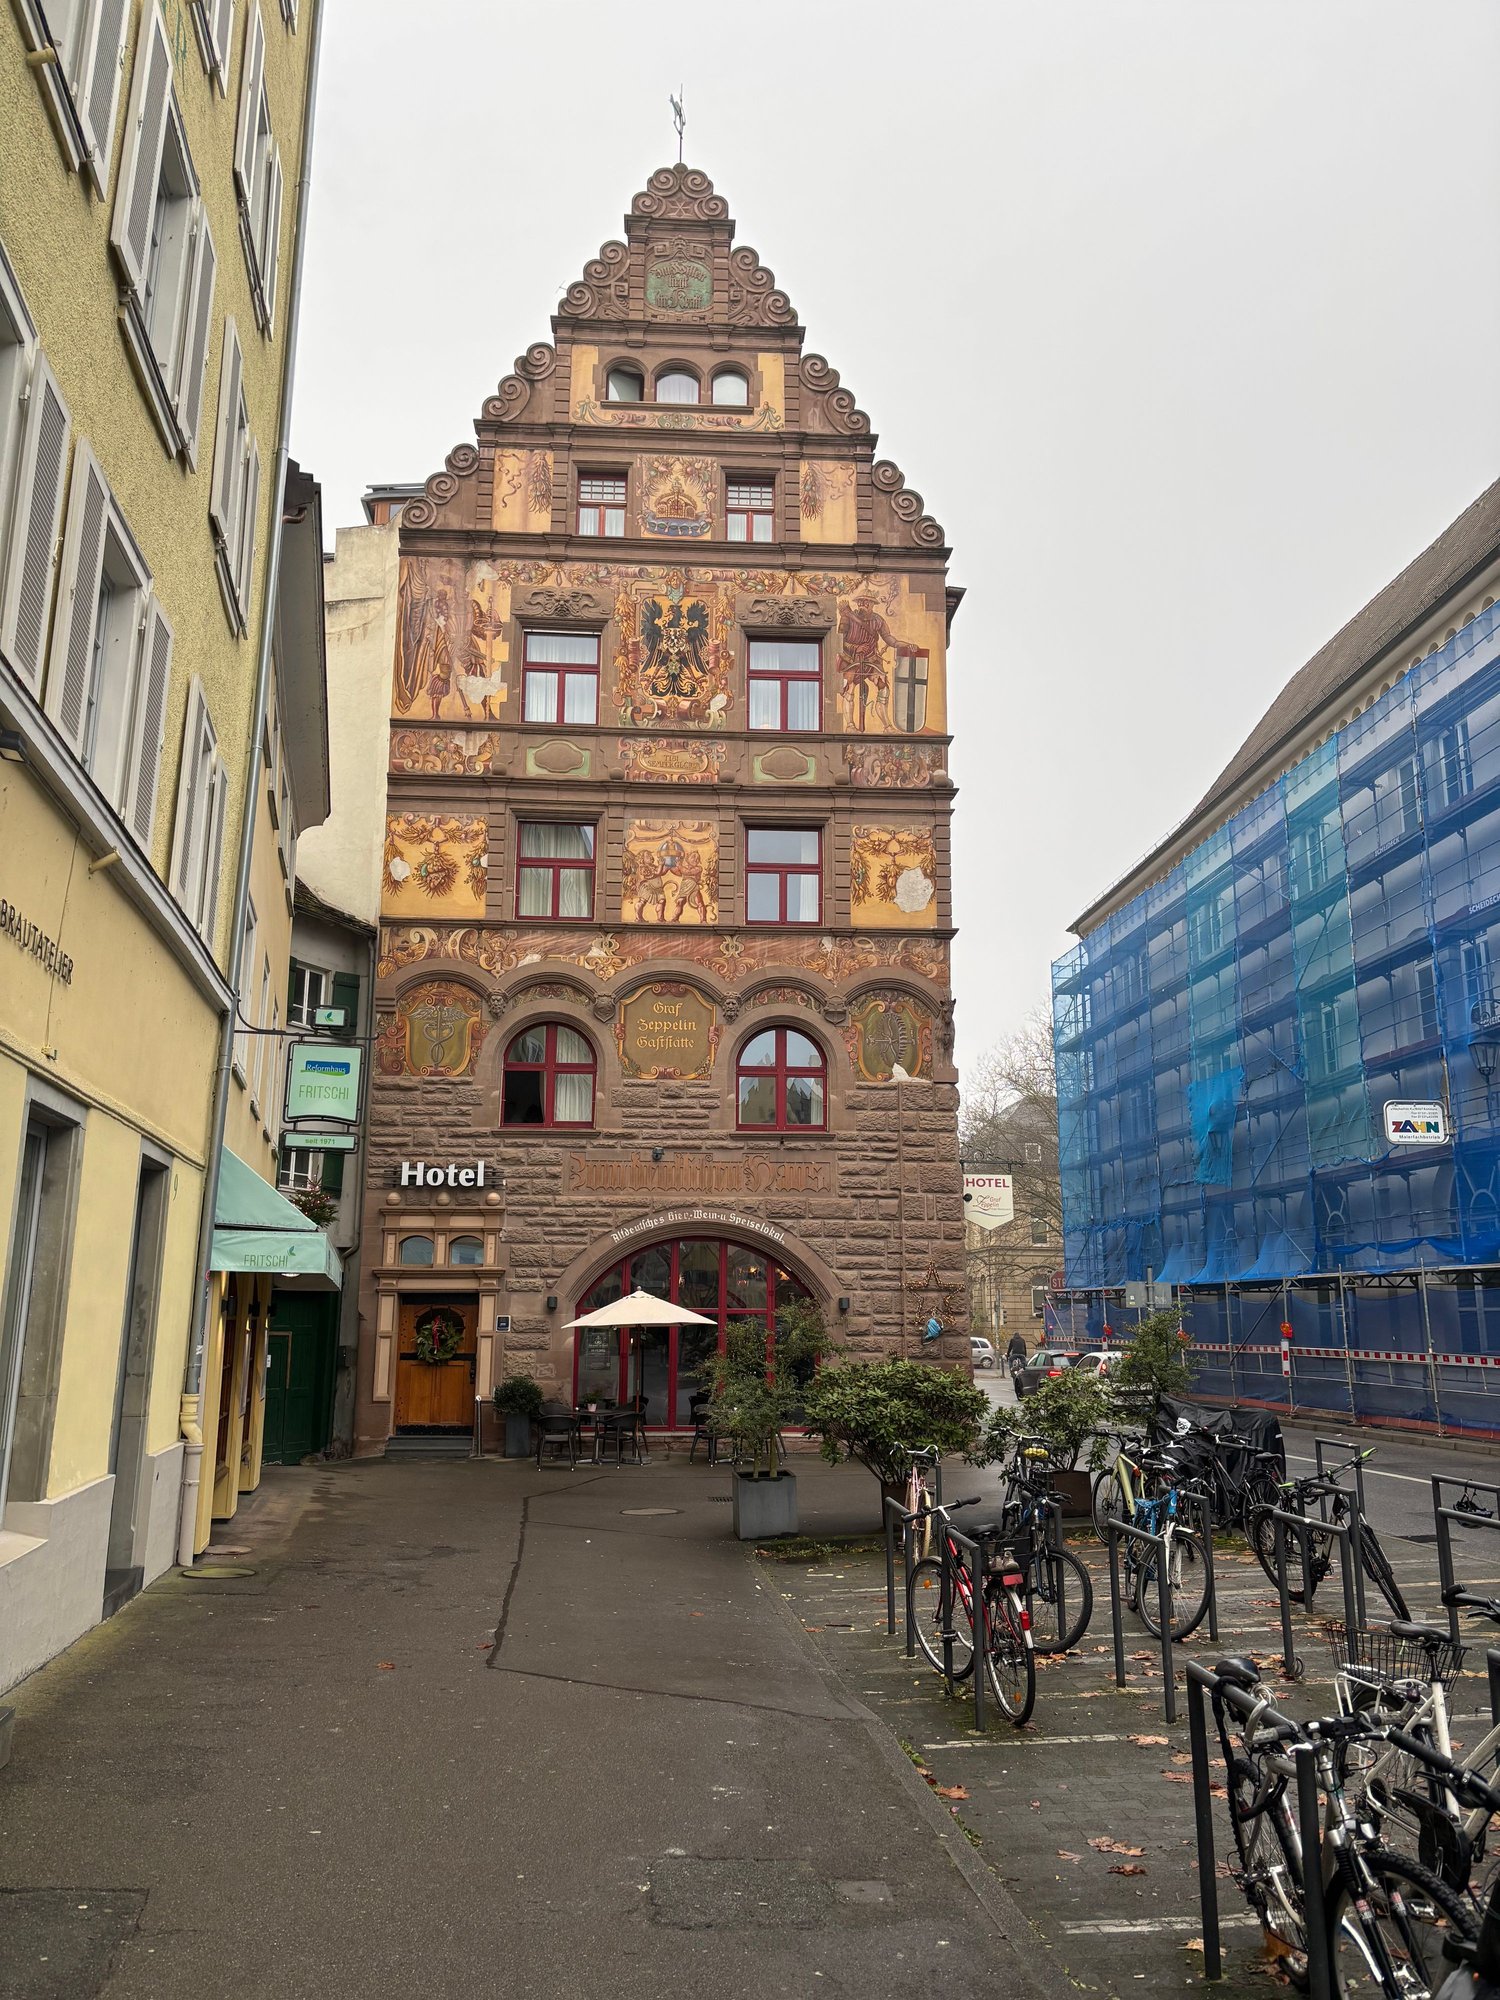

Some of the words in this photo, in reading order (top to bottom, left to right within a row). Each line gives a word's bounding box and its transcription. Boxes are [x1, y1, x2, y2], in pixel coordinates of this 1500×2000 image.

[0, 898, 74, 985] BRAUTATELIER
[653, 1001, 683, 1017] Graf
[637, 1018, 697, 1033] Zeppelin
[307, 1063, 347, 1074] Reformhaus
[298, 1084, 349, 1100] FRITSCHI
[1392, 1120, 1440, 1133] ZAHN
[401, 1160, 485, 1187] Hotel
[173, 1173, 179, 1201] 9
[965, 1177, 1010, 1188] HOTEL
[243, 1254, 288, 1268] FRITSCHI
[1052, 1277, 1067, 1288] STO
